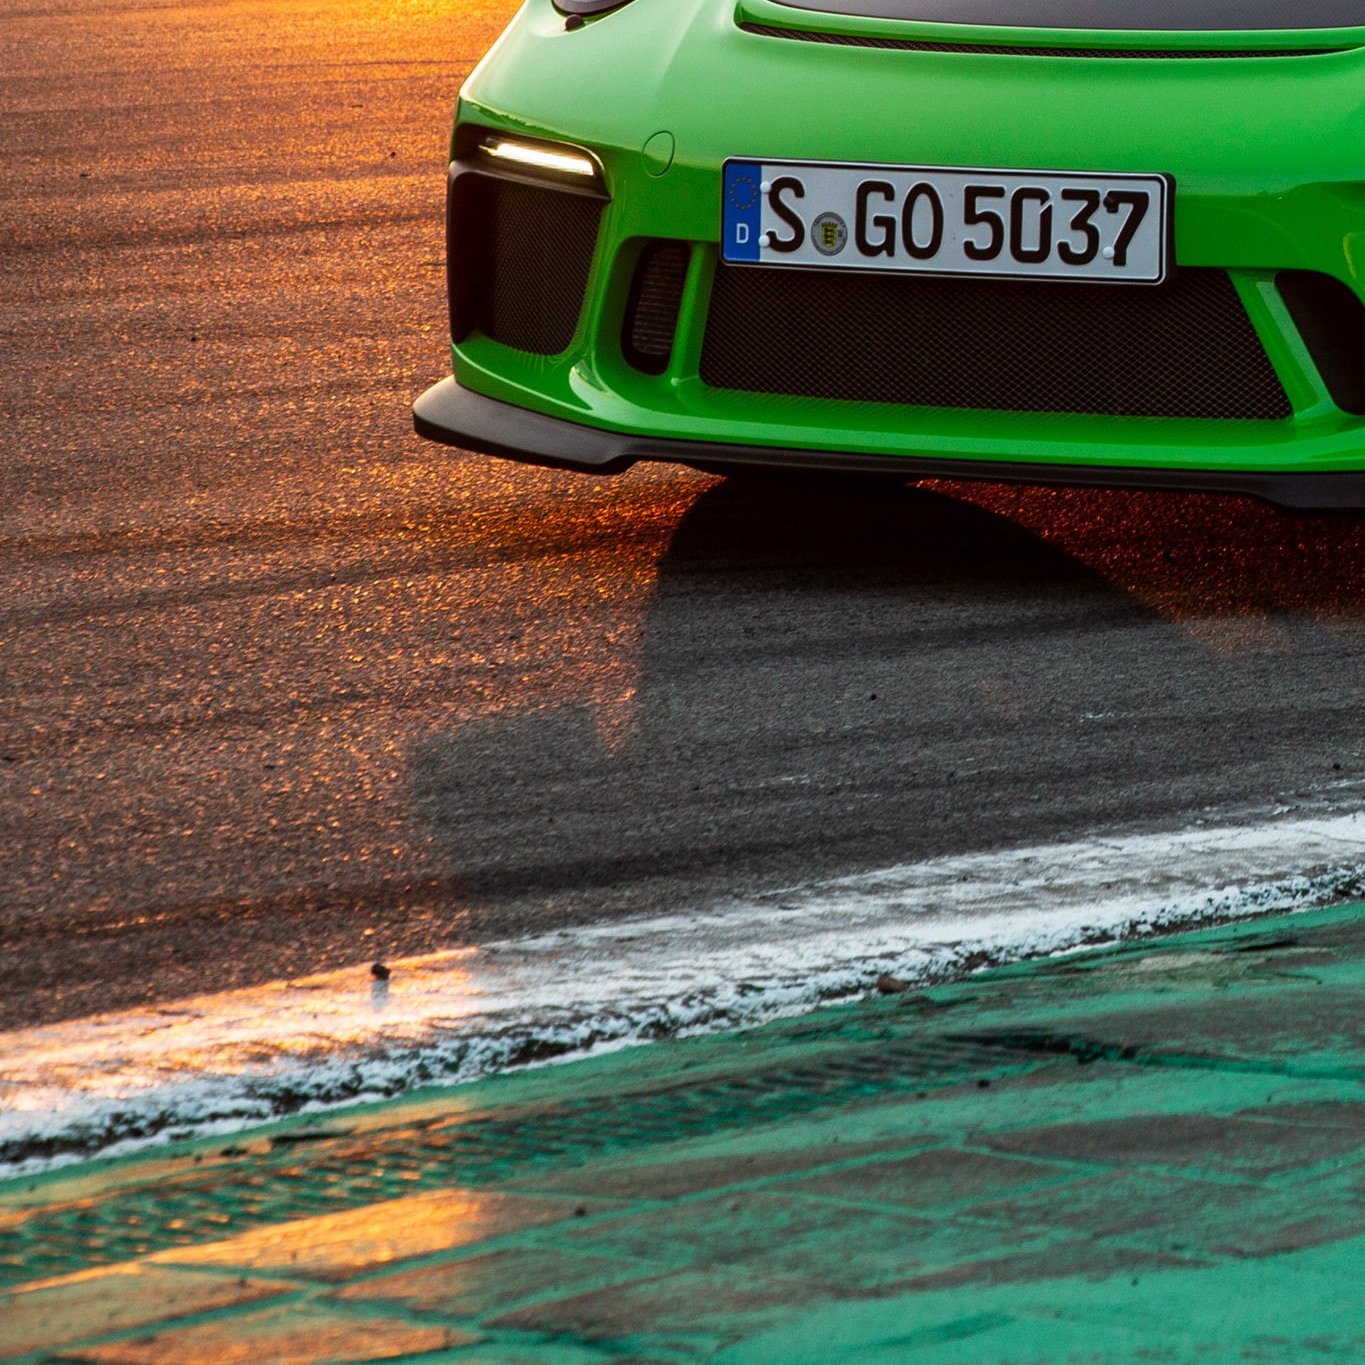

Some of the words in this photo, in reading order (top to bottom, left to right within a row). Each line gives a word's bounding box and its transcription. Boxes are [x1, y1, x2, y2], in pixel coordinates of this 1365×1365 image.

[736, 222, 749, 244] D
[764, 175, 806, 253] S
[855, 179, 945, 260] GO
[963, 184, 1150, 267] 5037
